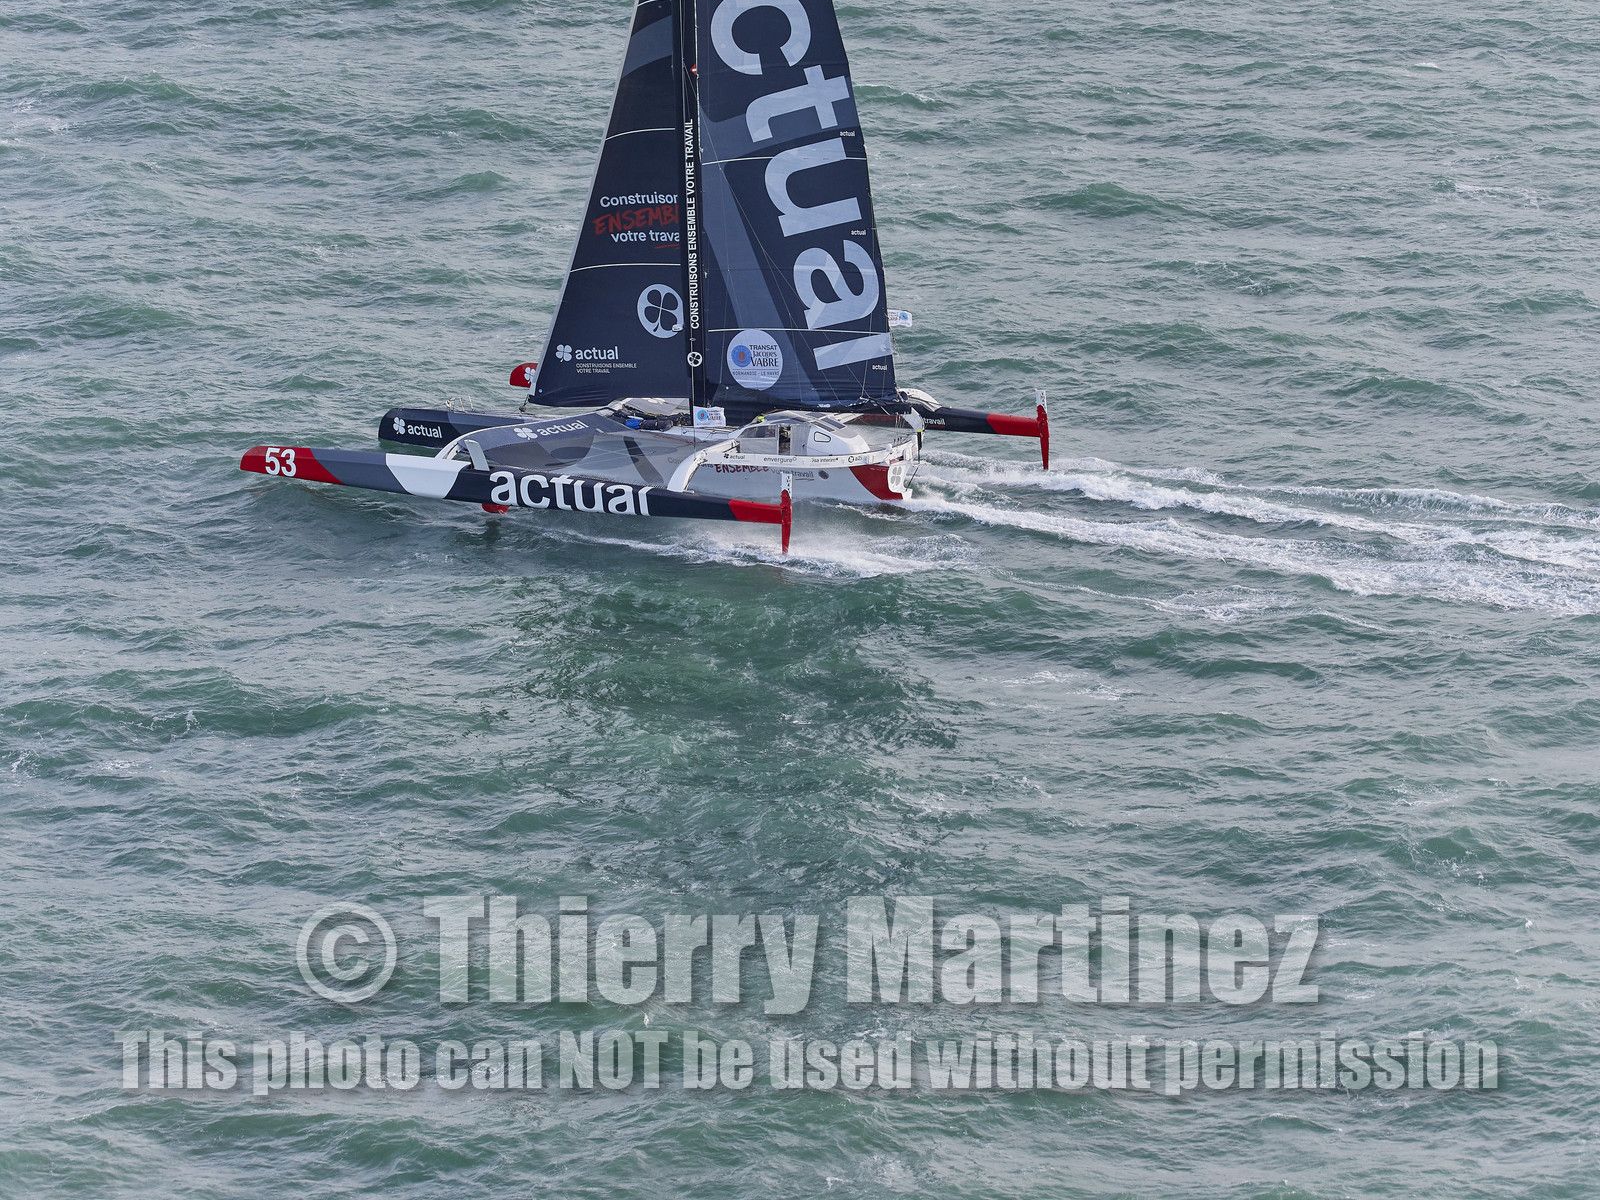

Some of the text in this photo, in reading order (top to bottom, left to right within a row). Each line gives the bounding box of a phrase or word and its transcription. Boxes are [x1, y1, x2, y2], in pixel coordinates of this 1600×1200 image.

[684, 119, 700, 330] CONSTRUISONS ENSEMBLE VOTRE TRAVAIL
[611, 229, 680, 242] votre trava
[575, 346, 619, 360] actual
[750, 356, 779, 367] VABRE
[407, 425, 442, 439] actual
[536, 420, 589, 436] actual
[265, 447, 297, 477] 53
[489, 471, 654, 516] actual
